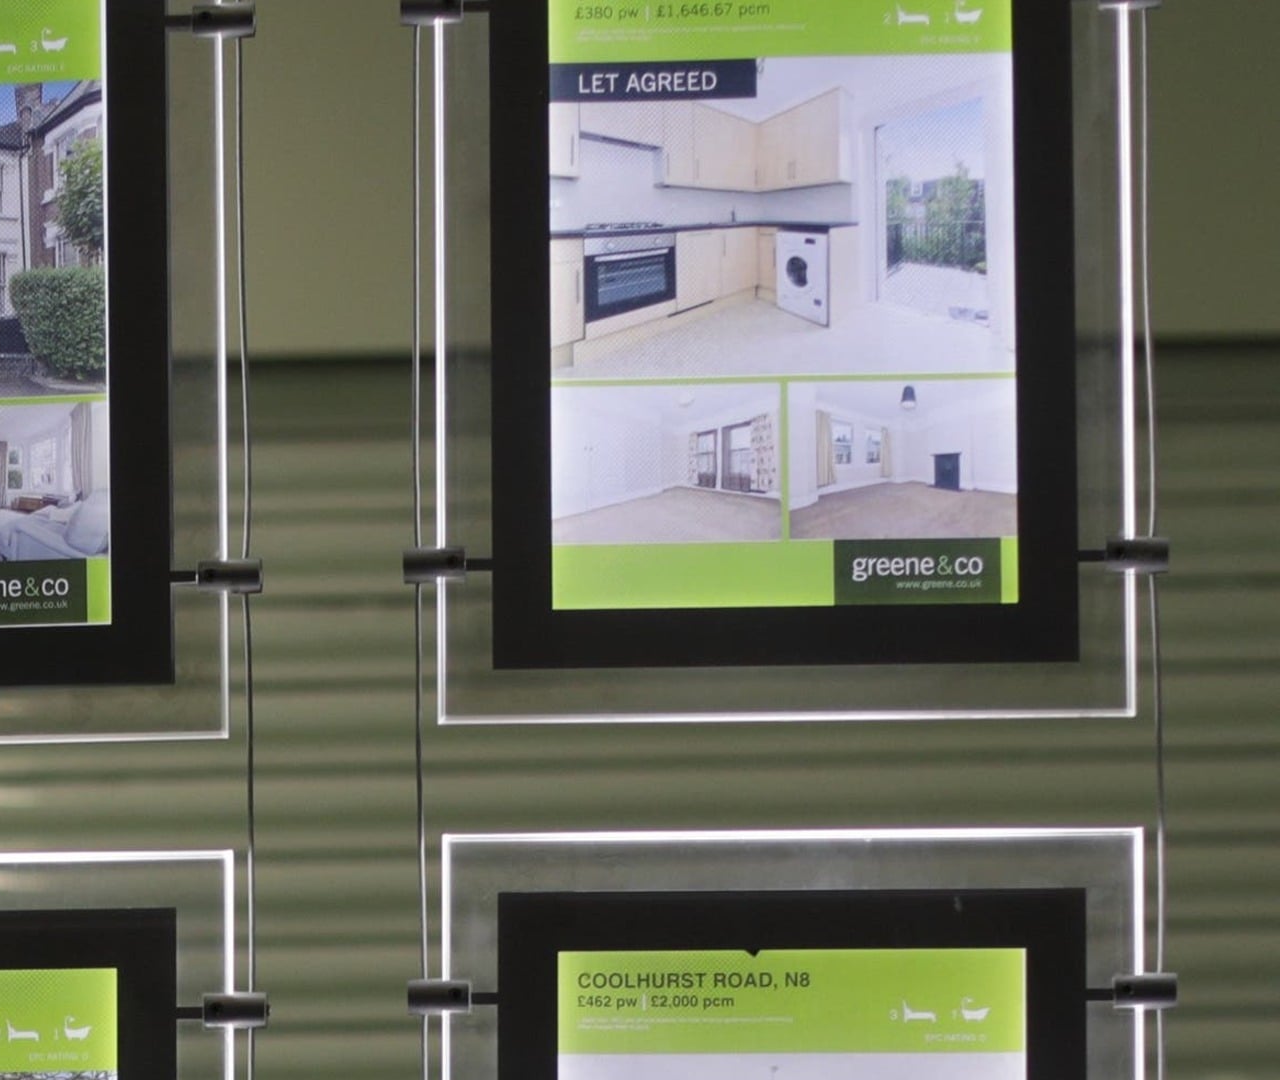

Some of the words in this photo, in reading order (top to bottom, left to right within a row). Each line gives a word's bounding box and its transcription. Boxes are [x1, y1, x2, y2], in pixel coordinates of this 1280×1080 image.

[575, 5, 613, 20] £380
[618, 7, 639, 21] pw
[656, 2, 734, 18] £1,646.67
[738, 3, 770, 18] pcm
[578, 73, 619, 94] LET
[625, 71, 718, 93] AGREED
[577, 972, 707, 989] COOLHURST
[713, 972, 778, 990] ROAD,
[784, 972, 810, 987] N8
[577, 995, 612, 1008] £462
[616, 997, 638, 1011] pw
[651, 994, 698, 1009] £2,000
[702, 997, 734, 1011] pcm
